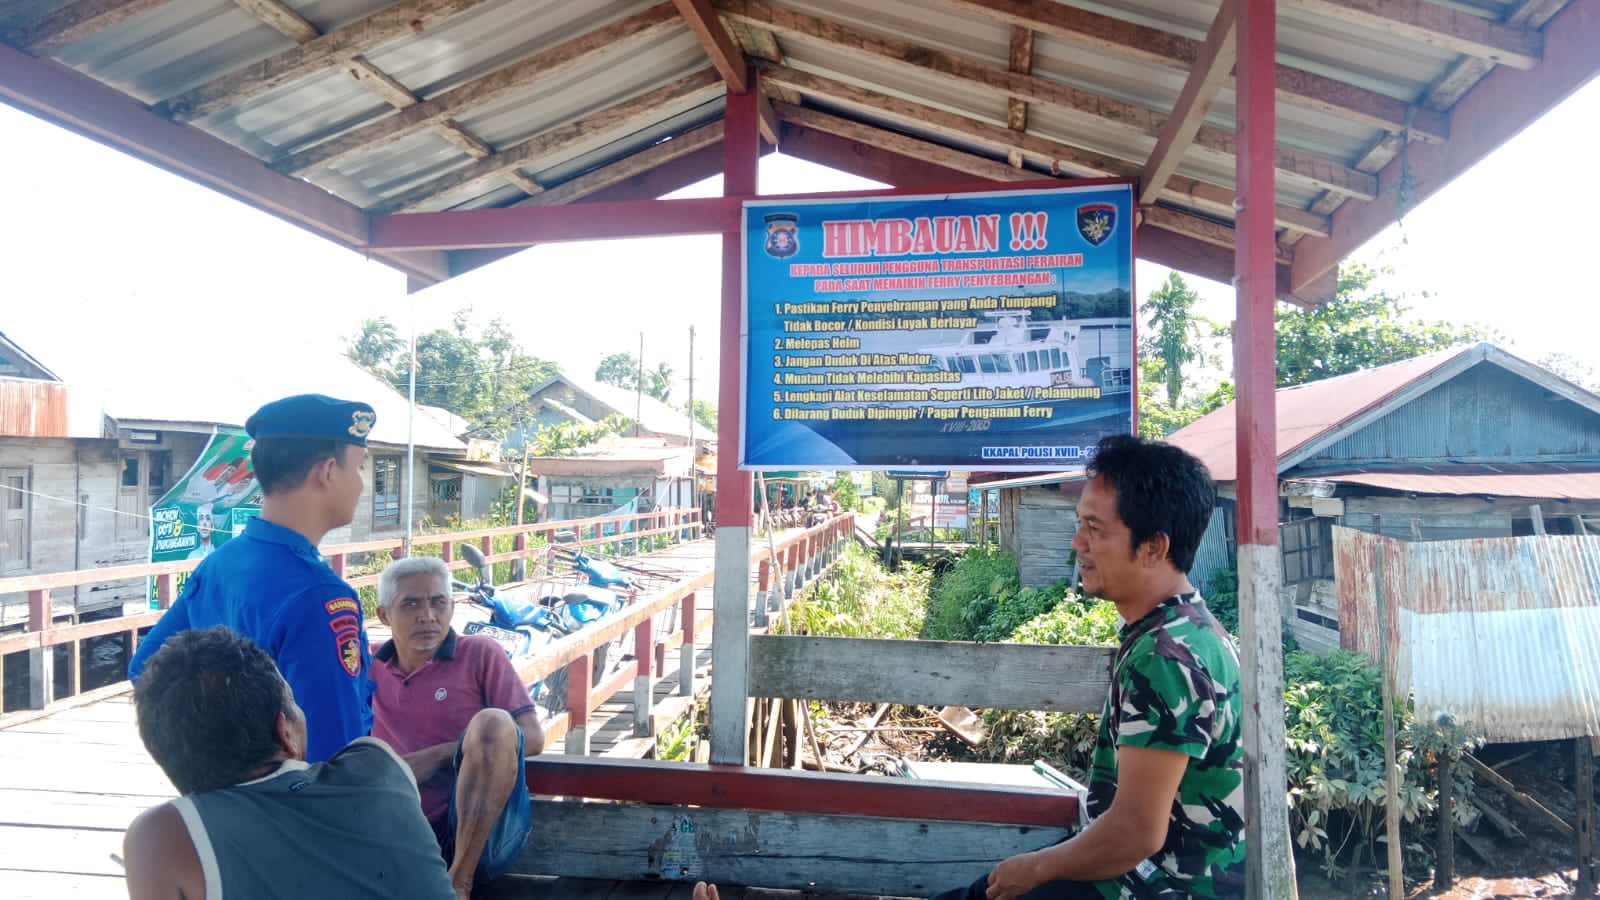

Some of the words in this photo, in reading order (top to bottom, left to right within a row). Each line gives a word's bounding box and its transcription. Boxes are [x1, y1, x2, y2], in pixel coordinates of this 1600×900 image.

[823, 215, 1000, 257] HIMBAUAN
[1009, 212, 1048, 251] !!!
[790, 264, 830, 276] KEPADA
[833, 262, 880, 275] SELURUH
[882, 260, 939, 274] PENGGUNA
[941, 256, 1024, 271] TRANSPORTASI
[1026, 253, 1083, 268] PERAIRAN
[815, 280, 842, 292] PADA
[844, 279, 871, 291] SAAT
[873, 276, 926, 290] MENAIKIN
[928, 275, 961, 288] FERRY
[775, 303, 783, 315] 1.
[784, 302, 829, 314] Pastikan
[832, 301, 859, 314] Ferry
[861, 300, 938, 314] Penyebrangan
[941, 298, 967, 311] yang
[969, 296, 998, 309] Anda
[1000, 295, 1057, 309] Tumpangi
[783, 320, 812, 332] Tidak
[814, 320, 846, 332] Bocor
[847, 319, 853, 331] /
[855, 318, 895, 331] Kondisi
[898, 317, 928, 331] Layak
[930, 316, 977, 330] Berlayar
[774, 338, 784, 349] 2.
[785, 337, 830, 350] Melepas
[832, 337, 860, 349] Helm
[774, 356, 784, 367] 3.
[785, 355, 822, 368] Jangan
[825, 354, 858, 366] Duduk
[861, 354, 871, 366] Di
[873, 353, 896, 365] Atas
[899, 353, 931, 365] Motor
[774, 373, 784, 385] 4.
[785, 373, 824, 385] Muatan
[826, 372, 855, 384] Tidak
[857, 371, 904, 383] Melebihi
[907, 370, 961, 384] Kapasitas
[773, 390, 784, 402] 5.
[785, 390, 833, 403] Lengkapi
[834, 390, 855, 401] Alat
[857, 389, 928, 401] Keselamatan
[930, 388, 971, 401] Seperti
[973, 388, 993, 400] Life
[995, 387, 1025, 400] Jaket
[1026, 387, 1033, 399] /
[1035, 386, 1101, 399] Pelampung
[773, 408, 784, 420] 6.
[784, 408, 830, 421] Dilarang
[832, 407, 865, 419] Duduk
[867, 407, 917, 420] Dipinggir
[919, 406, 926, 419] /
[927, 406, 959, 419] Pagar
[961, 406, 1021, 419] Pengaman
[1023, 405, 1053, 418] Ferry
[982, 446, 1019, 458] KKAPAL
[1021, 446, 1053, 458] POLISI
[1054, 446, 1080, 458] XVIII
